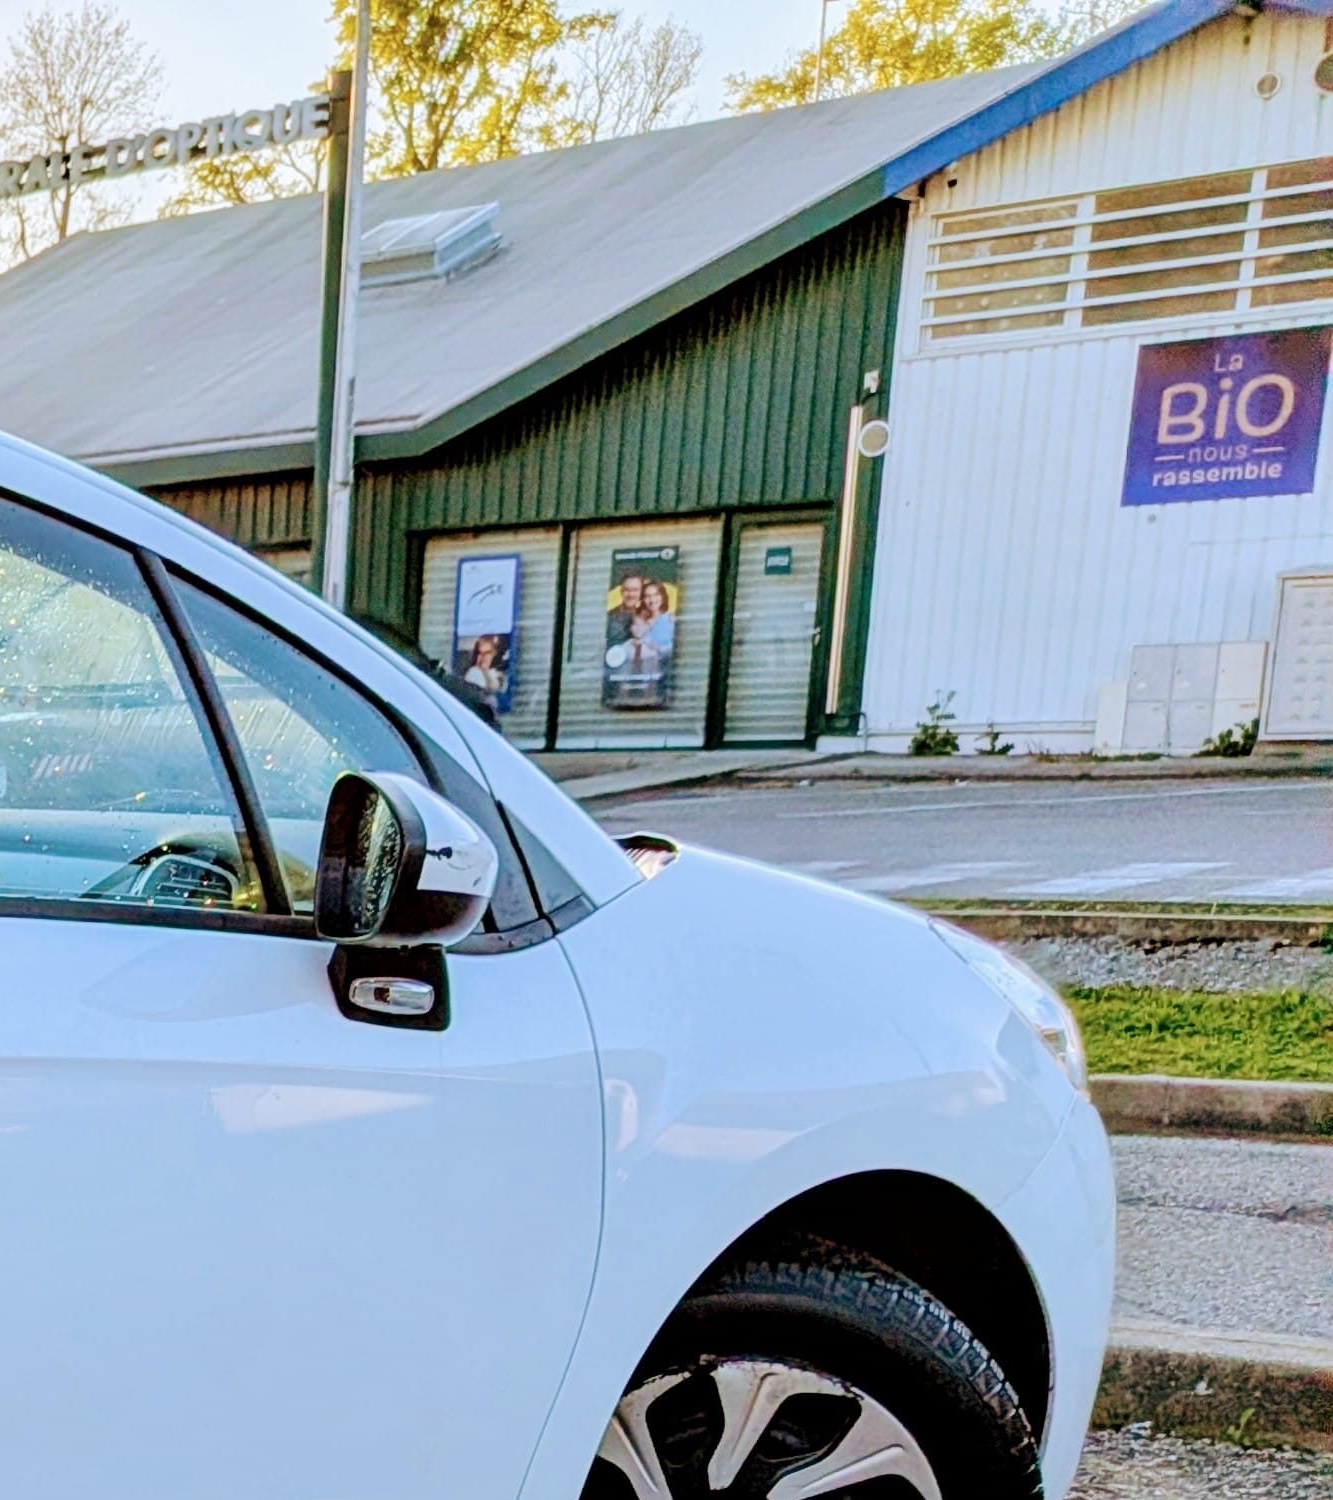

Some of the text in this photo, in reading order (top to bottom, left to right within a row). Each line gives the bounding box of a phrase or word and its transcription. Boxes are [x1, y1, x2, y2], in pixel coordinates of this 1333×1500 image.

[105, 95, 331, 177] D'OPTIQUE
[1214, 353, 1243, 372] La
[1157, 373, 1295, 445] BiO
[1188, 445, 1247, 463] nous
[1151, 462, 1282, 487] rassemble
